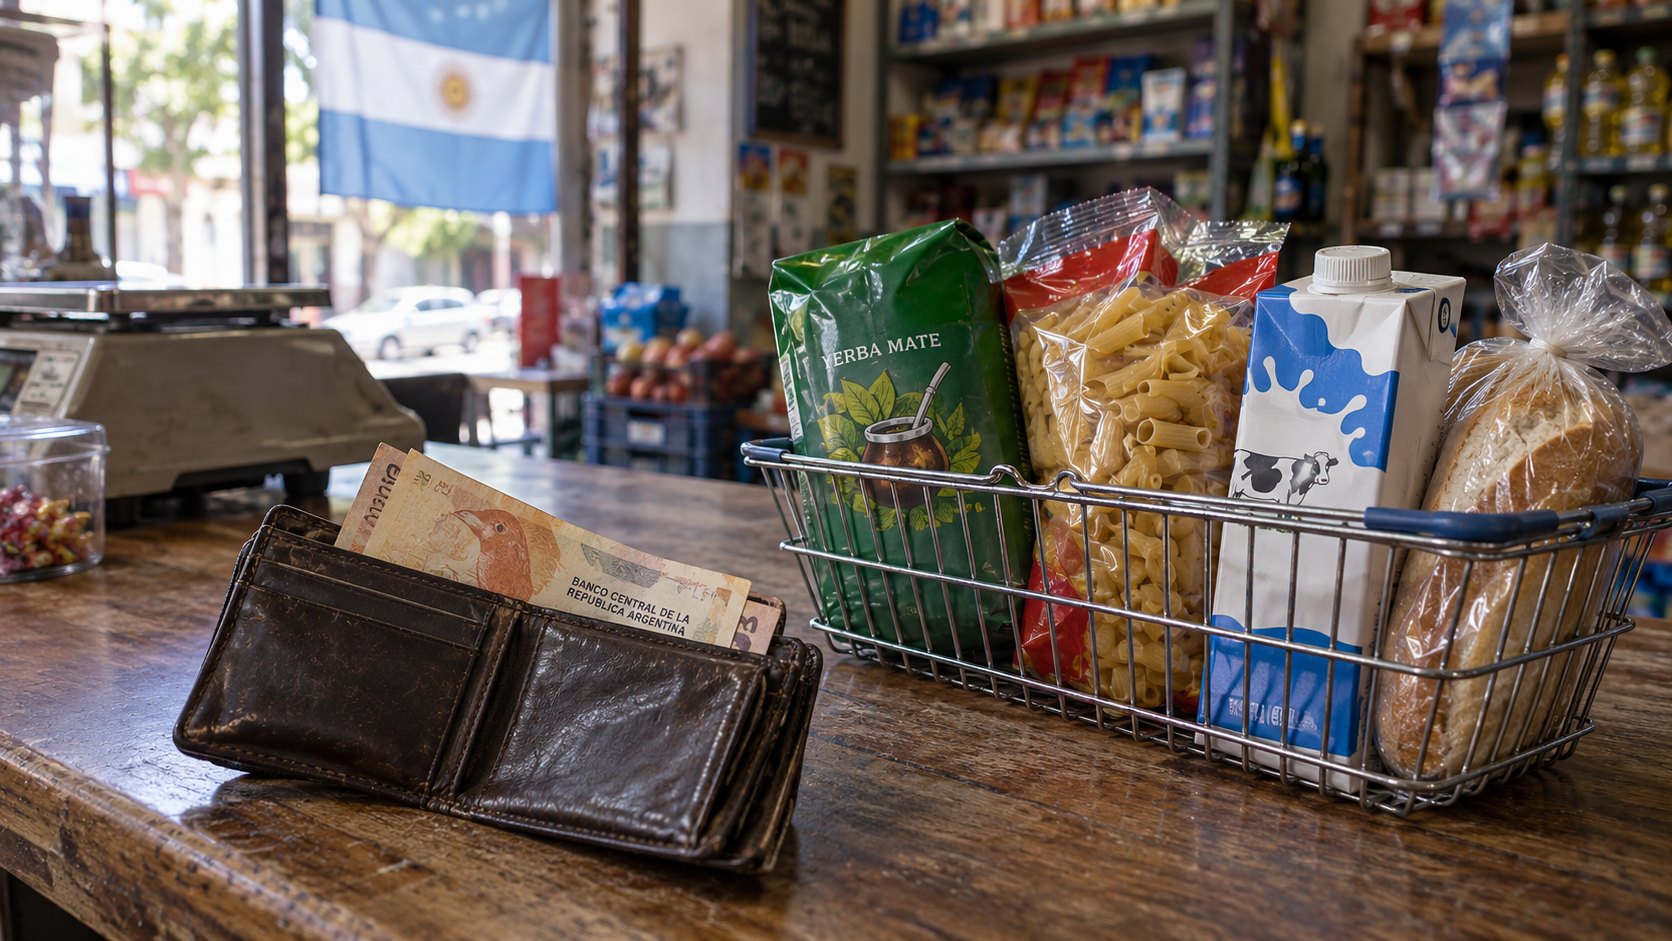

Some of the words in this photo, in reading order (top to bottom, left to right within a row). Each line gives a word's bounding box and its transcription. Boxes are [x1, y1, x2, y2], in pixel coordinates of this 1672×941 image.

[821, 343, 882, 369] YERBA
[887, 333, 941, 354] MATE
[567, 587, 624, 616] REPUBLICA
[627, 610, 685, 636] ARGENTINA
[571, 576, 608, 597] BANCO
[611, 591, 657, 614] CENTRAL
[660, 607, 675, 620] DE
[676, 612, 690, 624] LA
